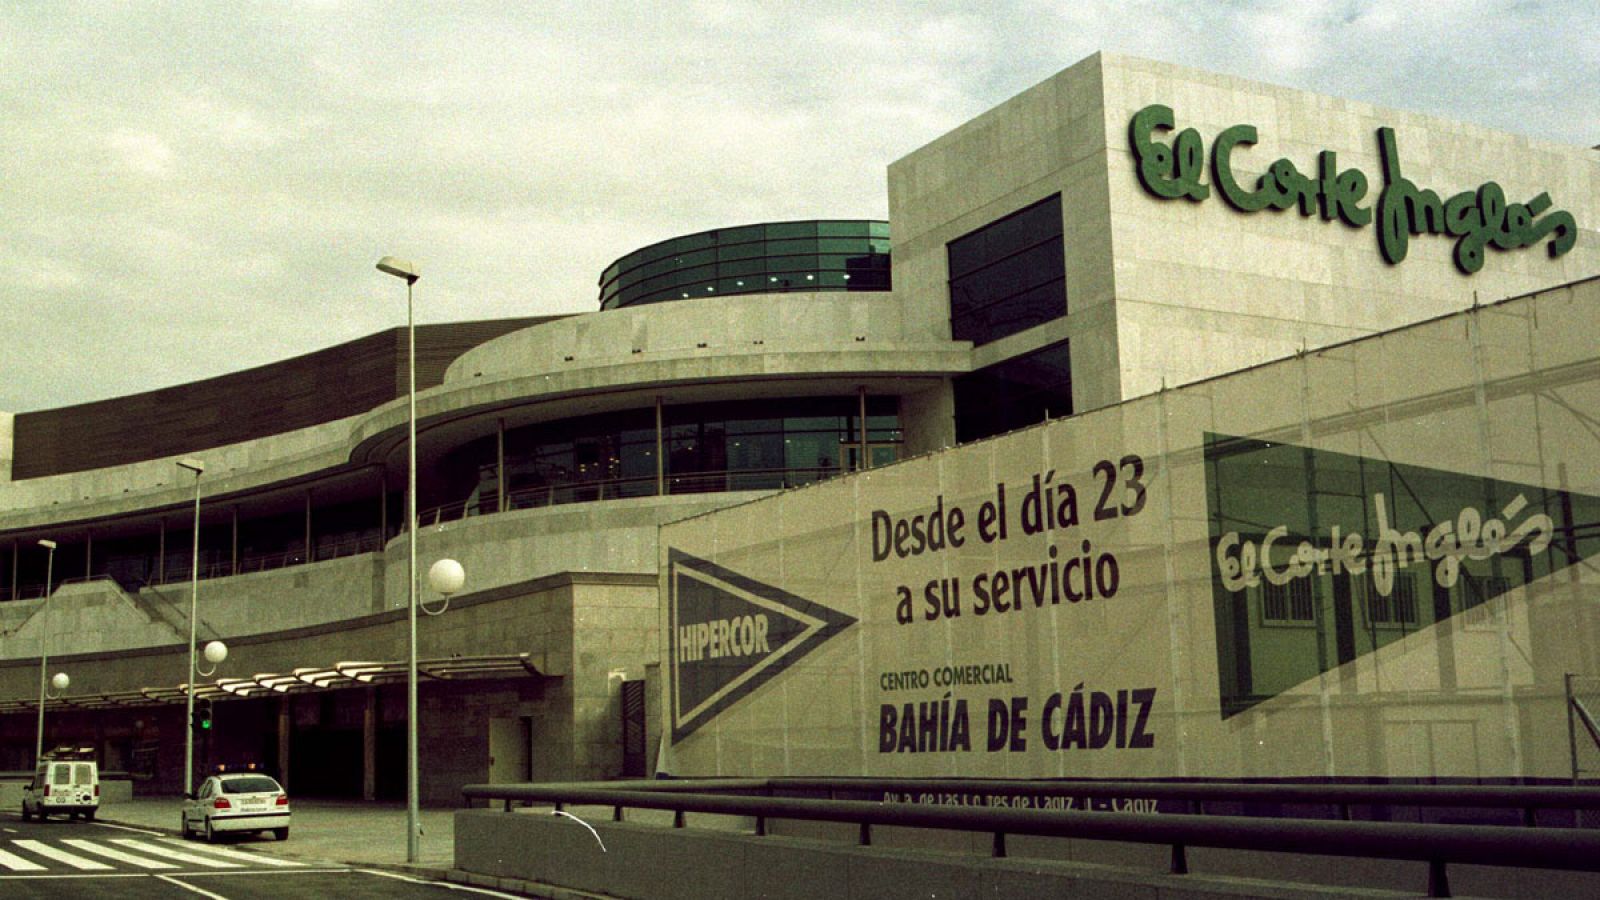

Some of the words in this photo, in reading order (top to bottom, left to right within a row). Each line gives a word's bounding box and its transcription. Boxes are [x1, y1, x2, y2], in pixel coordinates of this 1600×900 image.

[1129, 104, 1209, 200] El
[1211, 124, 1372, 228] Corte
[1376, 126, 1577, 274] Inglés
[872, 495, 965, 562] Desde
[977, 483, 1007, 543] el
[1021, 469, 1079, 536] día
[1092, 455, 1147, 521] 23
[1216, 532, 1260, 592] El
[1260, 525, 1368, 585] Corte
[1373, 493, 1553, 597] Inglés
[896, 586, 913, 625] a
[924, 577, 961, 621] su
[972, 539, 1119, 615] servicio
[680, 613, 769, 663] HIPERCOR
[880, 669, 929, 691] CENTRO
[933, 664, 1013, 687] COMERCIAL
[879, 691, 971, 753] BAHÍA
[987, 696, 1029, 752] DE
[1042, 682, 1157, 750] CÁDIZ
